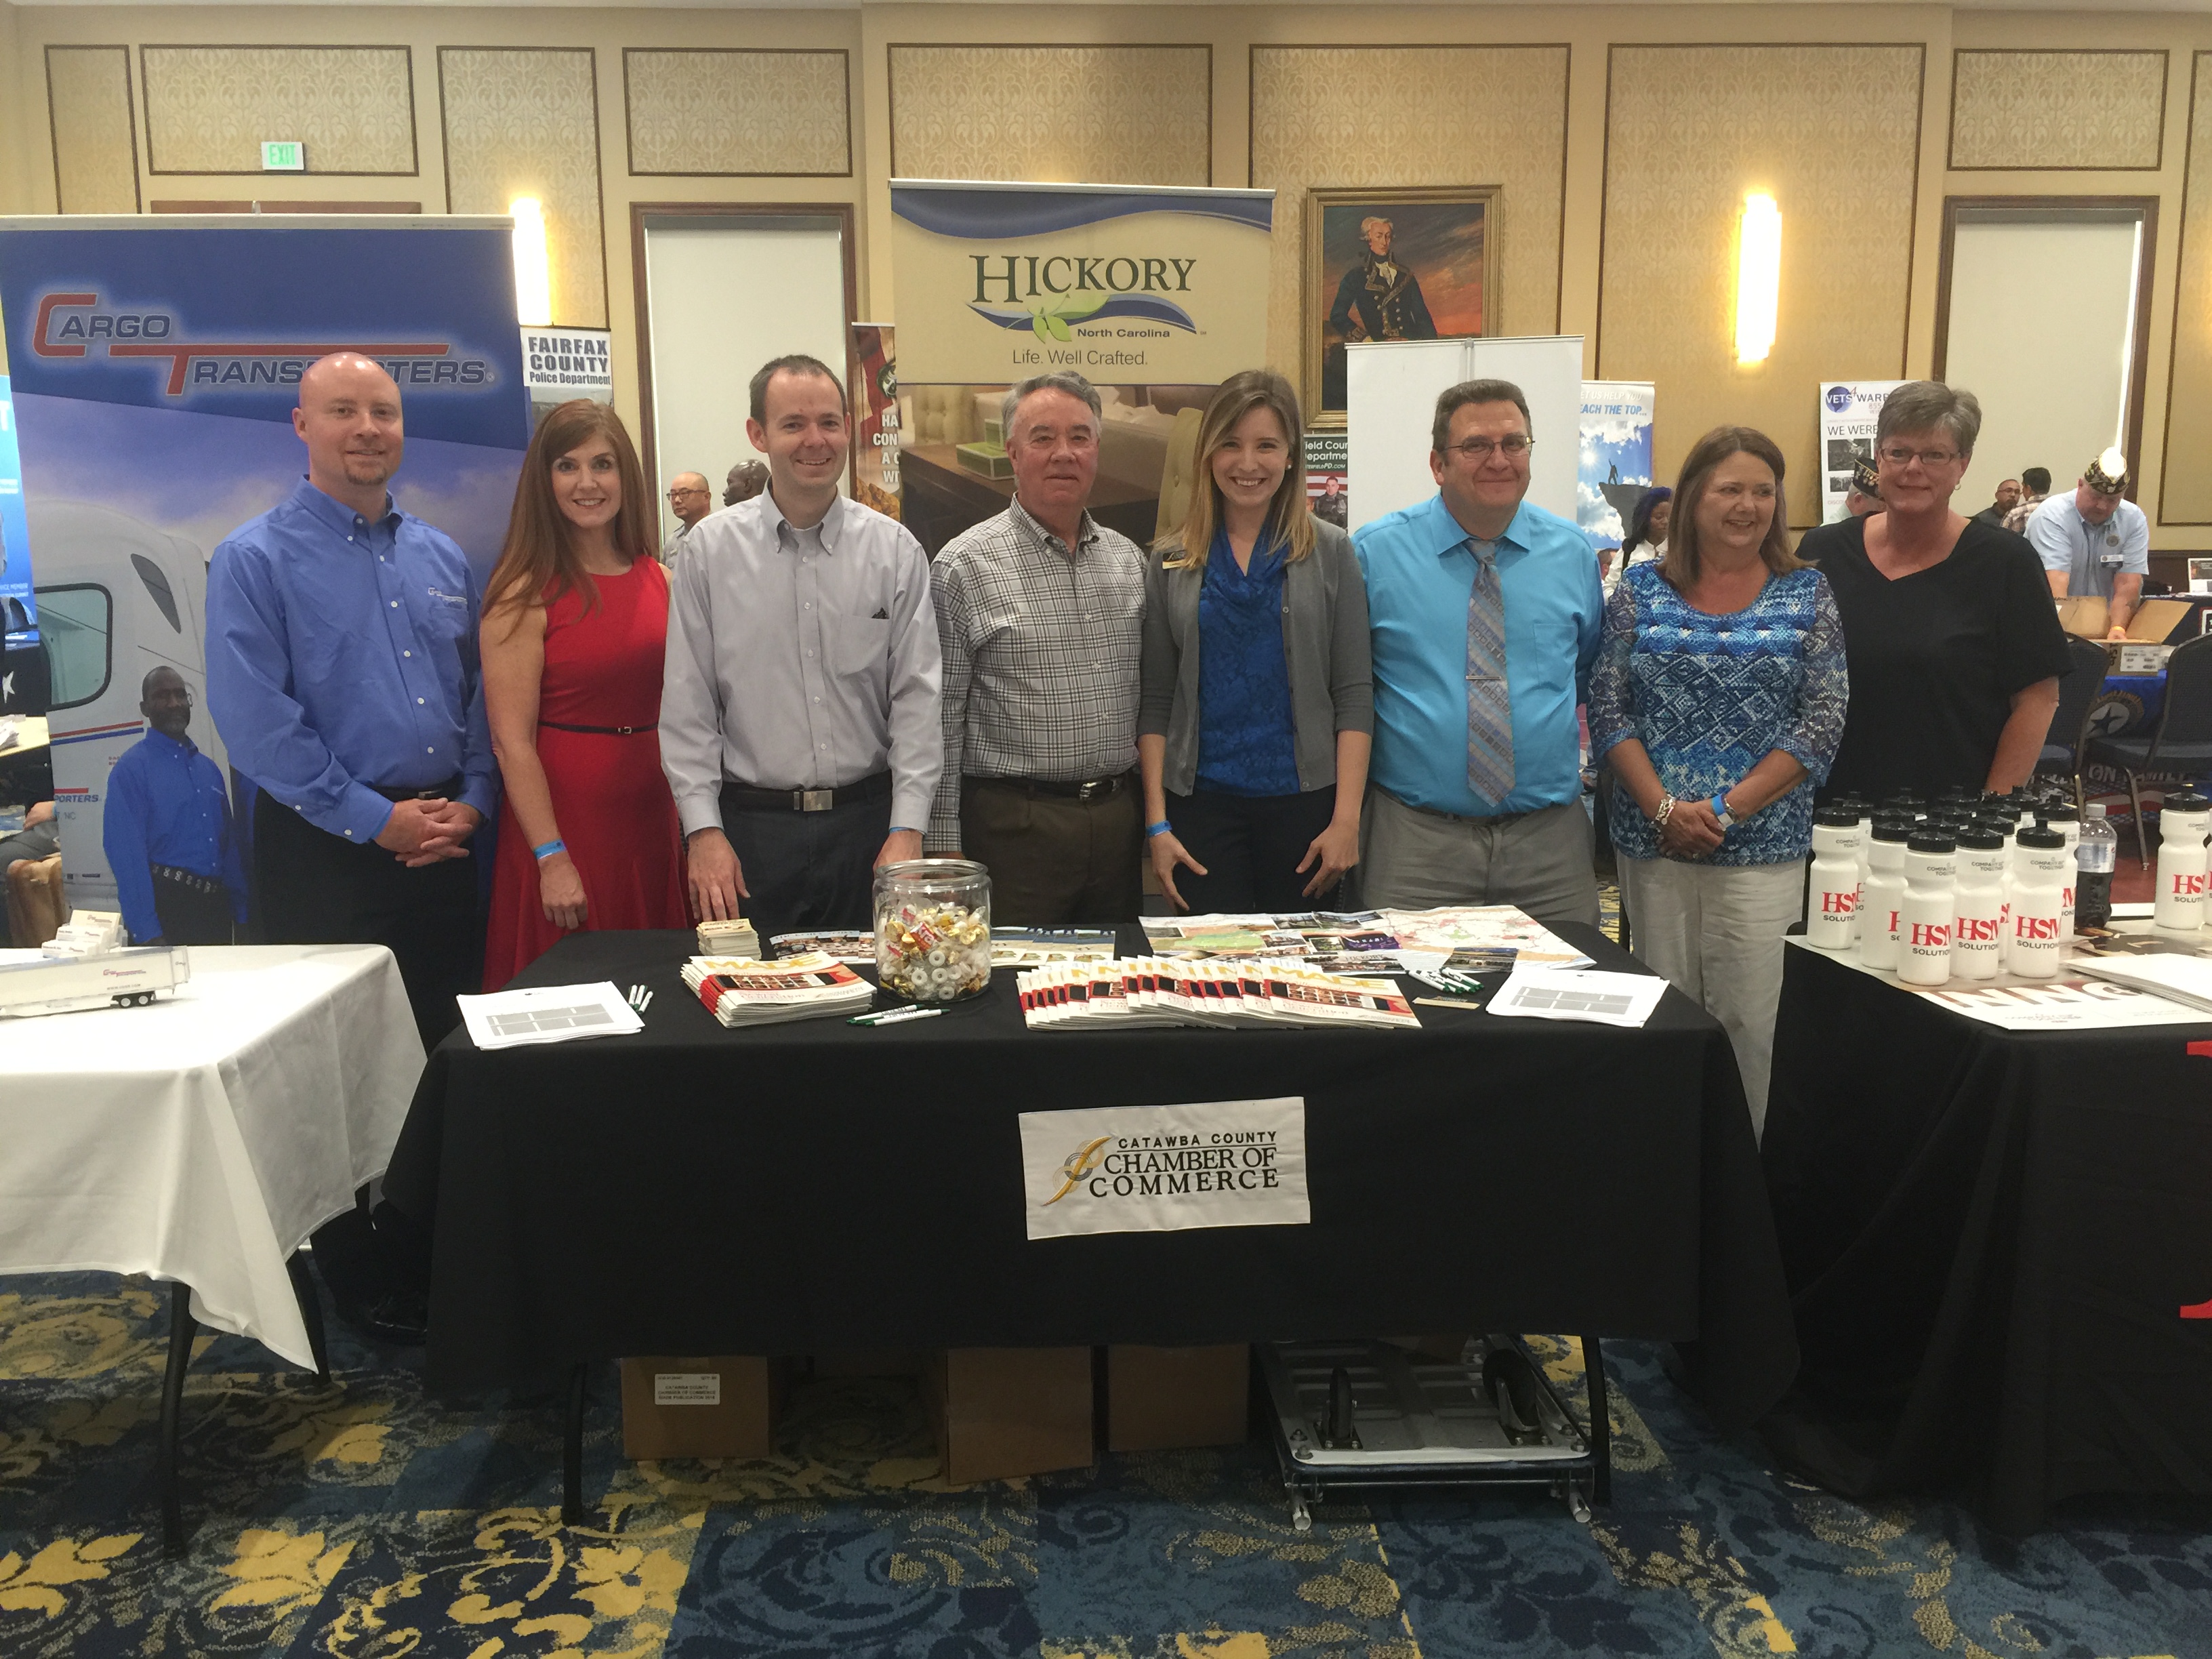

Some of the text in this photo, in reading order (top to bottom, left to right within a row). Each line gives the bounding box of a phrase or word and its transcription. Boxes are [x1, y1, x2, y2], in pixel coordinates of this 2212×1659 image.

[268, 144, 295, 165] EXIT
[969, 255, 1197, 303] HICKORY
[33, 293, 171, 358] CARGO
[1077, 328, 1113, 338] North
[1116, 328, 1170, 338] Carolina
[528, 336, 607, 355] FAIRFAX
[529, 354, 608, 372] COUNTY
[1012, 349, 1149, 365] Life. Well Crafted.
[529, 371, 611, 385] Police Department
[1603, 392, 1626, 400] HELP
[1625, 392, 1643, 401] YOU
[1826, 394, 1853, 404] VETS
[1604, 405, 1623, 415] THE
[1827, 426, 1845, 436] WE
[882, 452, 890, 464] A
[702, 954, 823, 970] MADE
[1269, 965, 1388, 989] MADE
[1118, 1130, 1277, 1149] CATAWBA COUNTY
[1103, 1147, 1277, 1175] CHAMBER OF
[1088, 1168, 1279, 1198] COMMERCE
